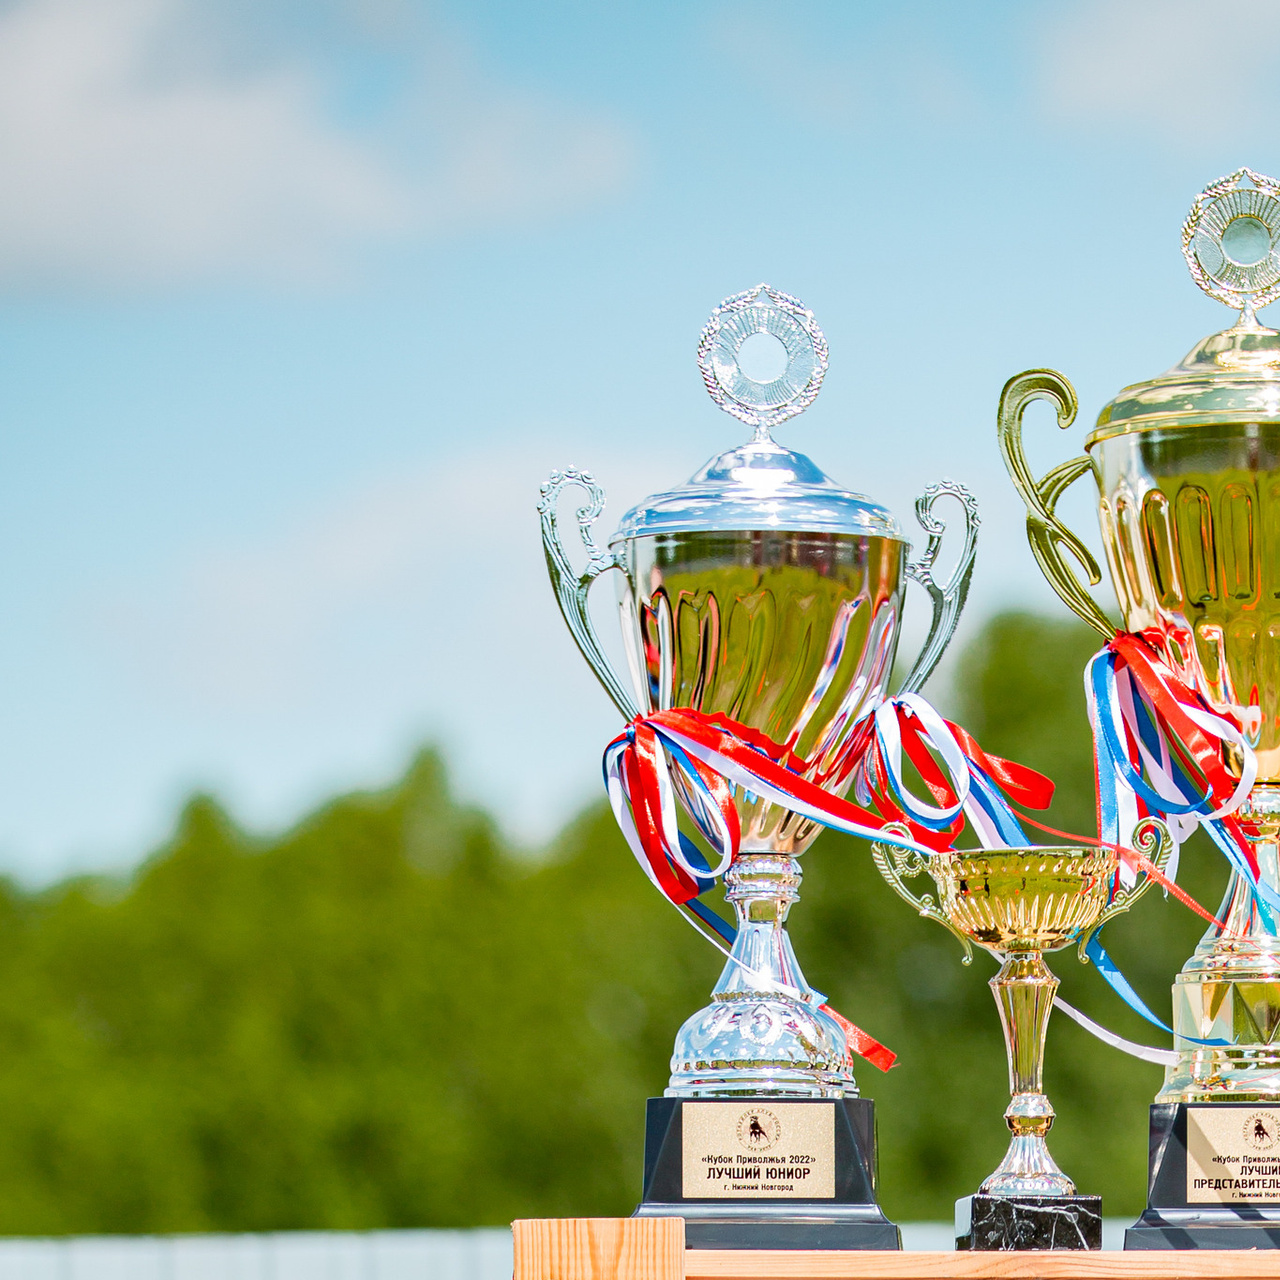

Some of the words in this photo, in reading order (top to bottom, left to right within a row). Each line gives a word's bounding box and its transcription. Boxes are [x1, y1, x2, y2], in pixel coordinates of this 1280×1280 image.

[701, 1154, 733, 1165] «Кубок
[736, 1155, 786, 1165] Приволжья
[789, 1154, 816, 1164] 2022»
[1212, 1155, 1240, 1165] «Кубок
[706, 1165, 761, 1179] ЛУЧШИЙ
[766, 1168, 811, 1179] ЮНИОР
[761, 1184, 794, 1192] Новгород
